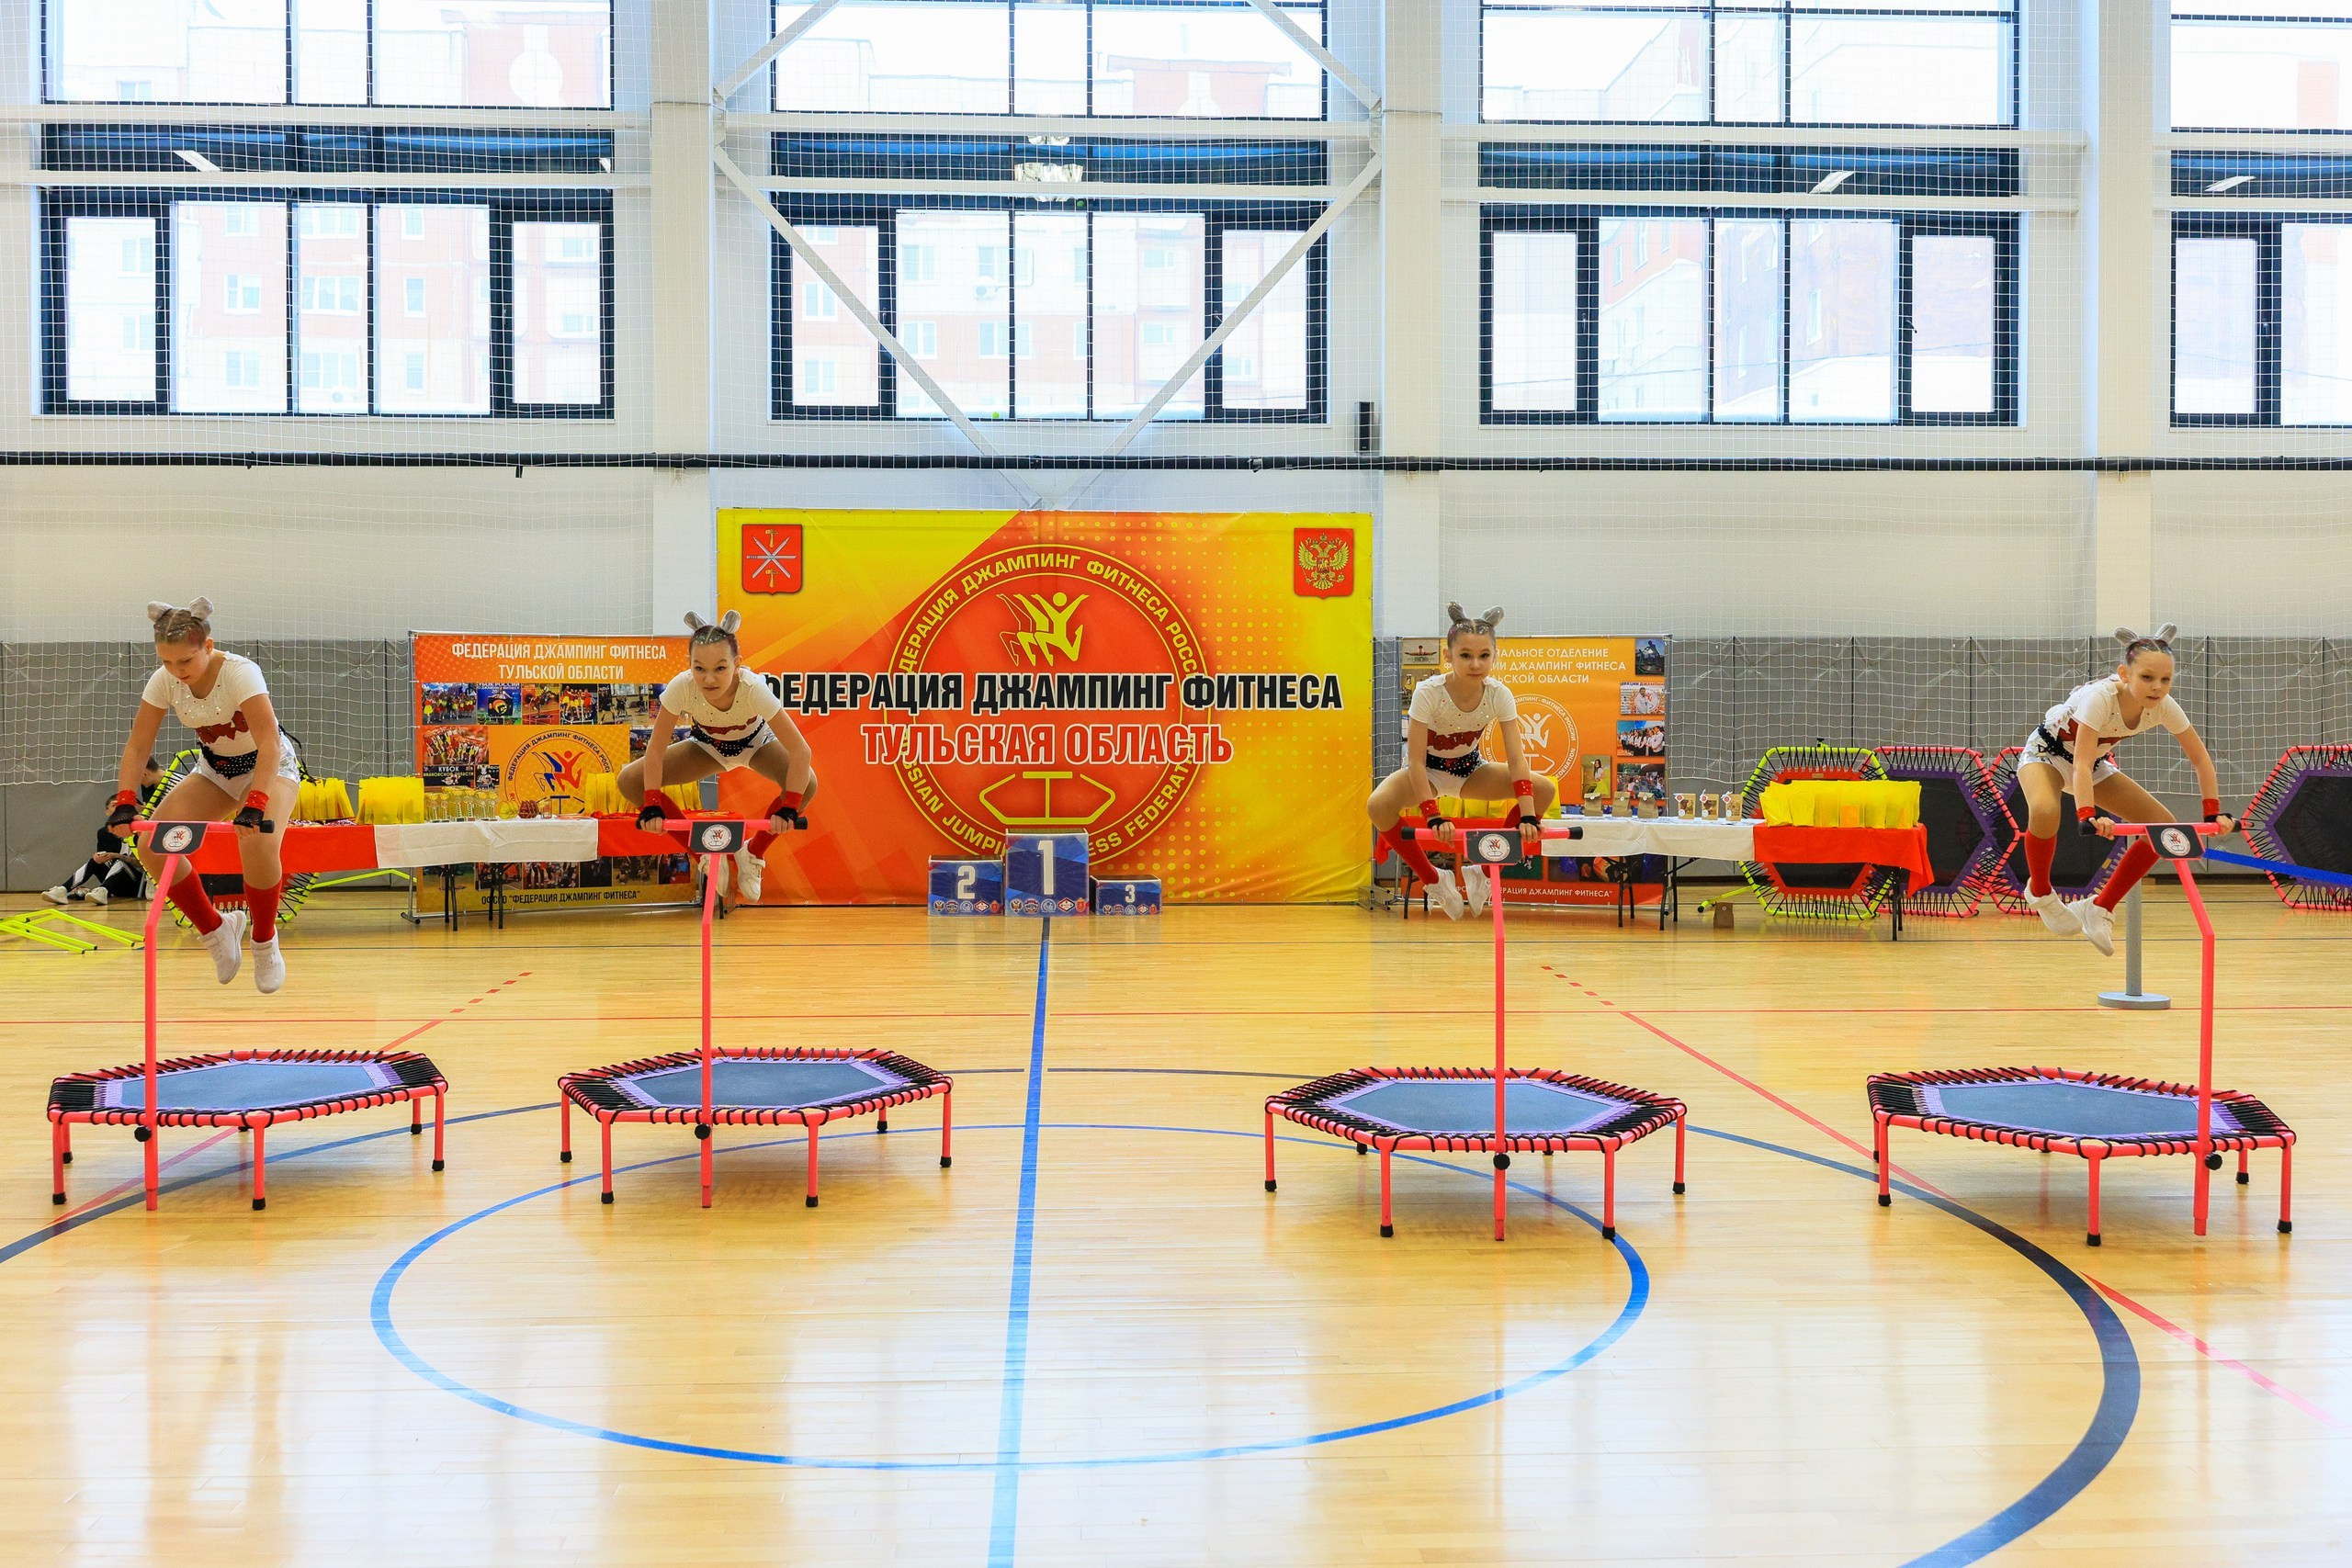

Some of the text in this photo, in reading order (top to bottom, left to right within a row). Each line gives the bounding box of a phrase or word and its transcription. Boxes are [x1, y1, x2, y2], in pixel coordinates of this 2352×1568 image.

[899, 553, 1198, 676] ДЕРАЦИЯ ДЖАМПИНГ ФИТНЕСА РОСС
[451, 643, 667, 660] ФЕДЕРАЦИЯ ДЖАМПИНГ ФИТНЕСА
[1496, 649, 1609, 659] АЛЬНОЕ ОТДЕЛЕНИЕ
[1510, 660, 1573, 671] ДЖАМПИНГ
[1576, 660, 1626, 671] ФИТНЕСА
[498, 662, 624, 680] ТУЛЬСКОЙ ОБЛАСТИ
[1489, 672, 1589, 684] ЬСКОЙ ОБЛАСТИ
[971, 672, 1173, 716] ДЖАМПИНГ
[1182, 672, 1344, 710] ФИТНЕСА
[1565, 716, 1577, 741] РОССИИ
[507, 732, 611, 782] ФЕДЕРАЦИЯ ДЖАМПИНГ ФИТНЕСА РОСС
[861, 723, 1233, 764] ТУЛЬСКАЯ ОБЛАСТЬ
[1555, 748, 1576, 779] EDERATION
[902, 744, 1005, 857] SIAN JUMPI
[1124, 746, 1193, 838] FEDERAT
[957, 865, 976, 899] 2
[1037, 840, 1055, 896] 1
[559, 891, 603, 903] ДЖАМПИНГ
[1125, 884, 1136, 903] 3
[1529, 888, 1573, 897] ДЖАМПИНГ
